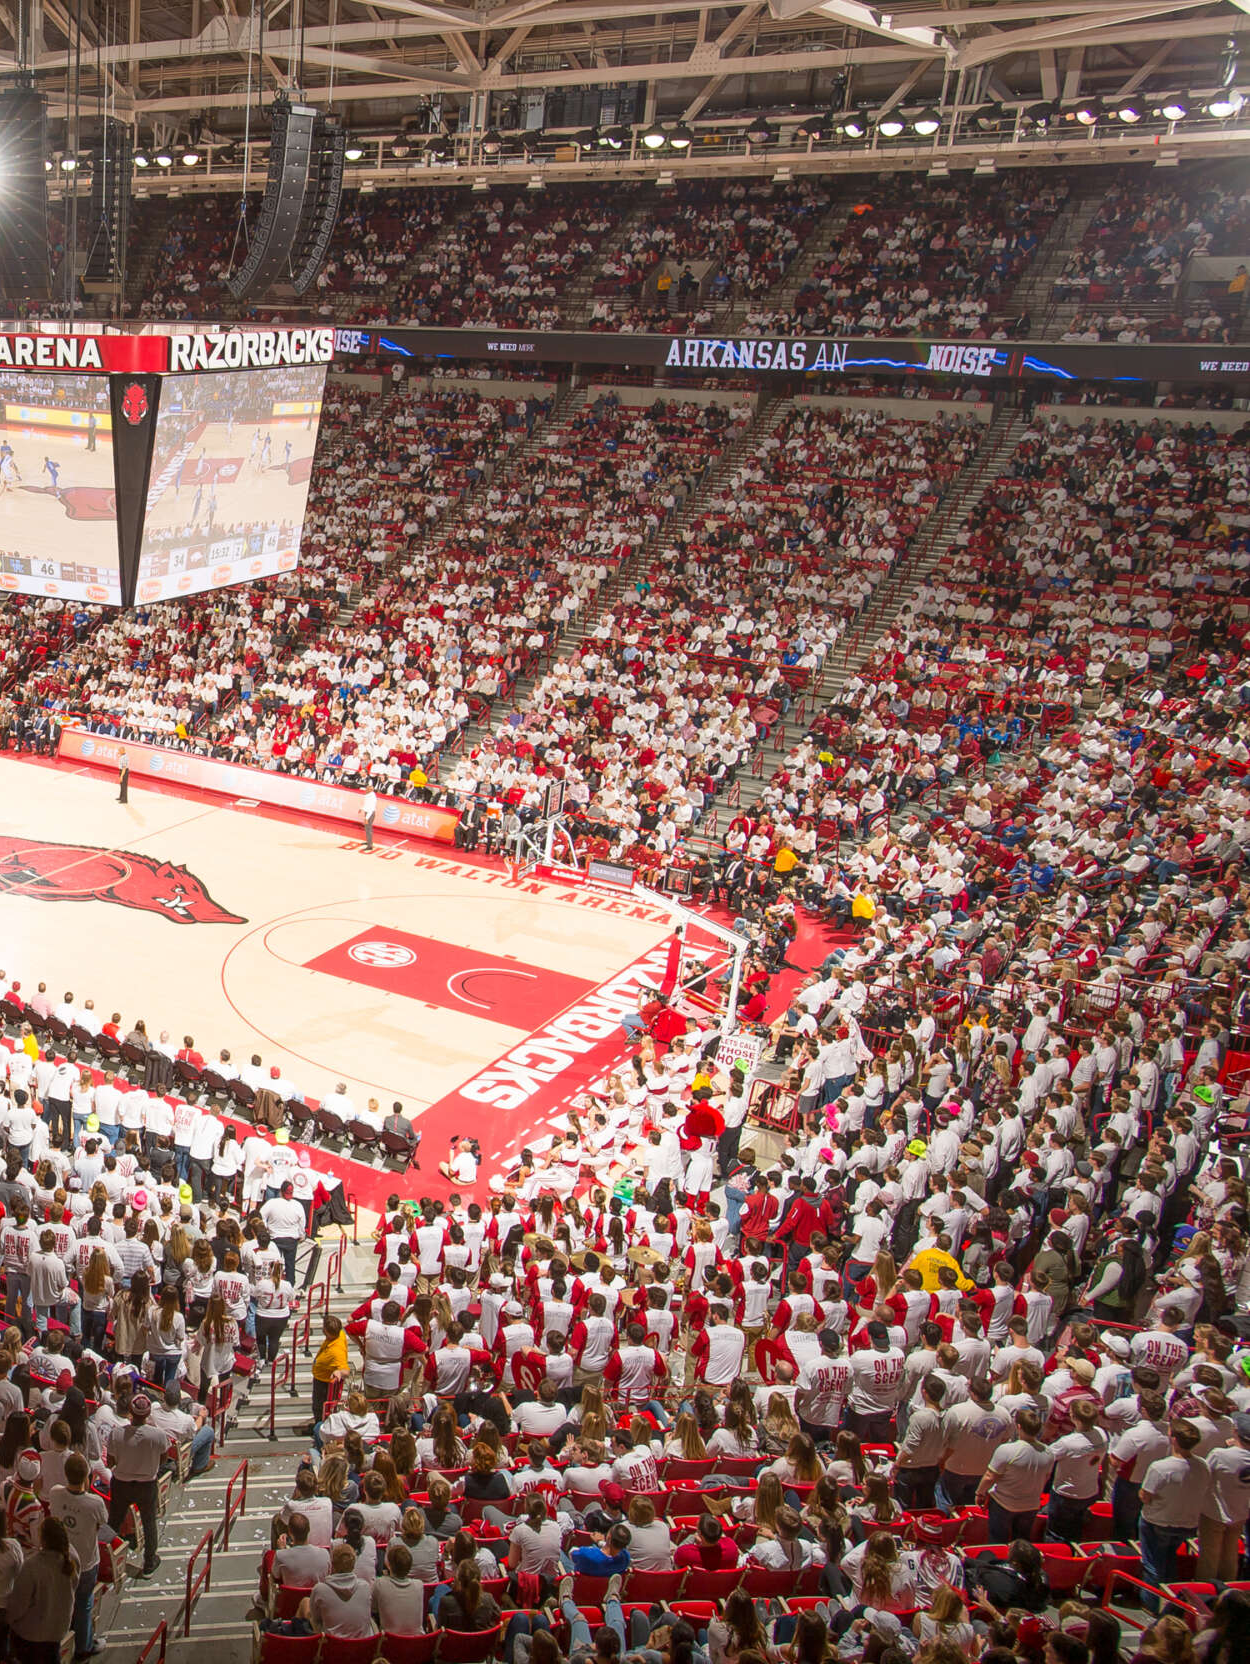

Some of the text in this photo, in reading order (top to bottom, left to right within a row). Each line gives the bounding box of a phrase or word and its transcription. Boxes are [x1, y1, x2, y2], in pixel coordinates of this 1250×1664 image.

[170, 329, 334, 371] RAZORBACKS
[487, 342, 499, 351] WE
[500, 343, 517, 351] NEED
[665, 339, 849, 372] ARKANSAS AN
[926, 344, 996, 377] NOISE
[1200, 361, 1250, 372] WE NEED
[40, 563, 55, 576] 46
[95, 745, 119, 761] at&t
[165, 761, 190, 775] at&t
[401, 812, 431, 829] at&t
[339, 840, 402, 860] BUD
[414, 856, 549, 896] WALTON
[554, 892, 673, 925] ARENA
[720, 1045, 756, 1059] THOSE
[739, 1040, 756, 1052] CALL
[5, 1234, 30, 1247] ON THE
[55, 1233, 69, 1244] THE
[79, 1244, 89, 1255] ON
[218, 1280, 243, 1291] ON THE
[265, 1293, 284, 1310] 71
[1147, 1340, 1183, 1358] ON THE
[818, 1366, 849, 1380] ON THE
[874, 1359, 888, 1373] ON
[629, 1464, 643, 1479] ON
[524, 1481, 537, 1492] ON
